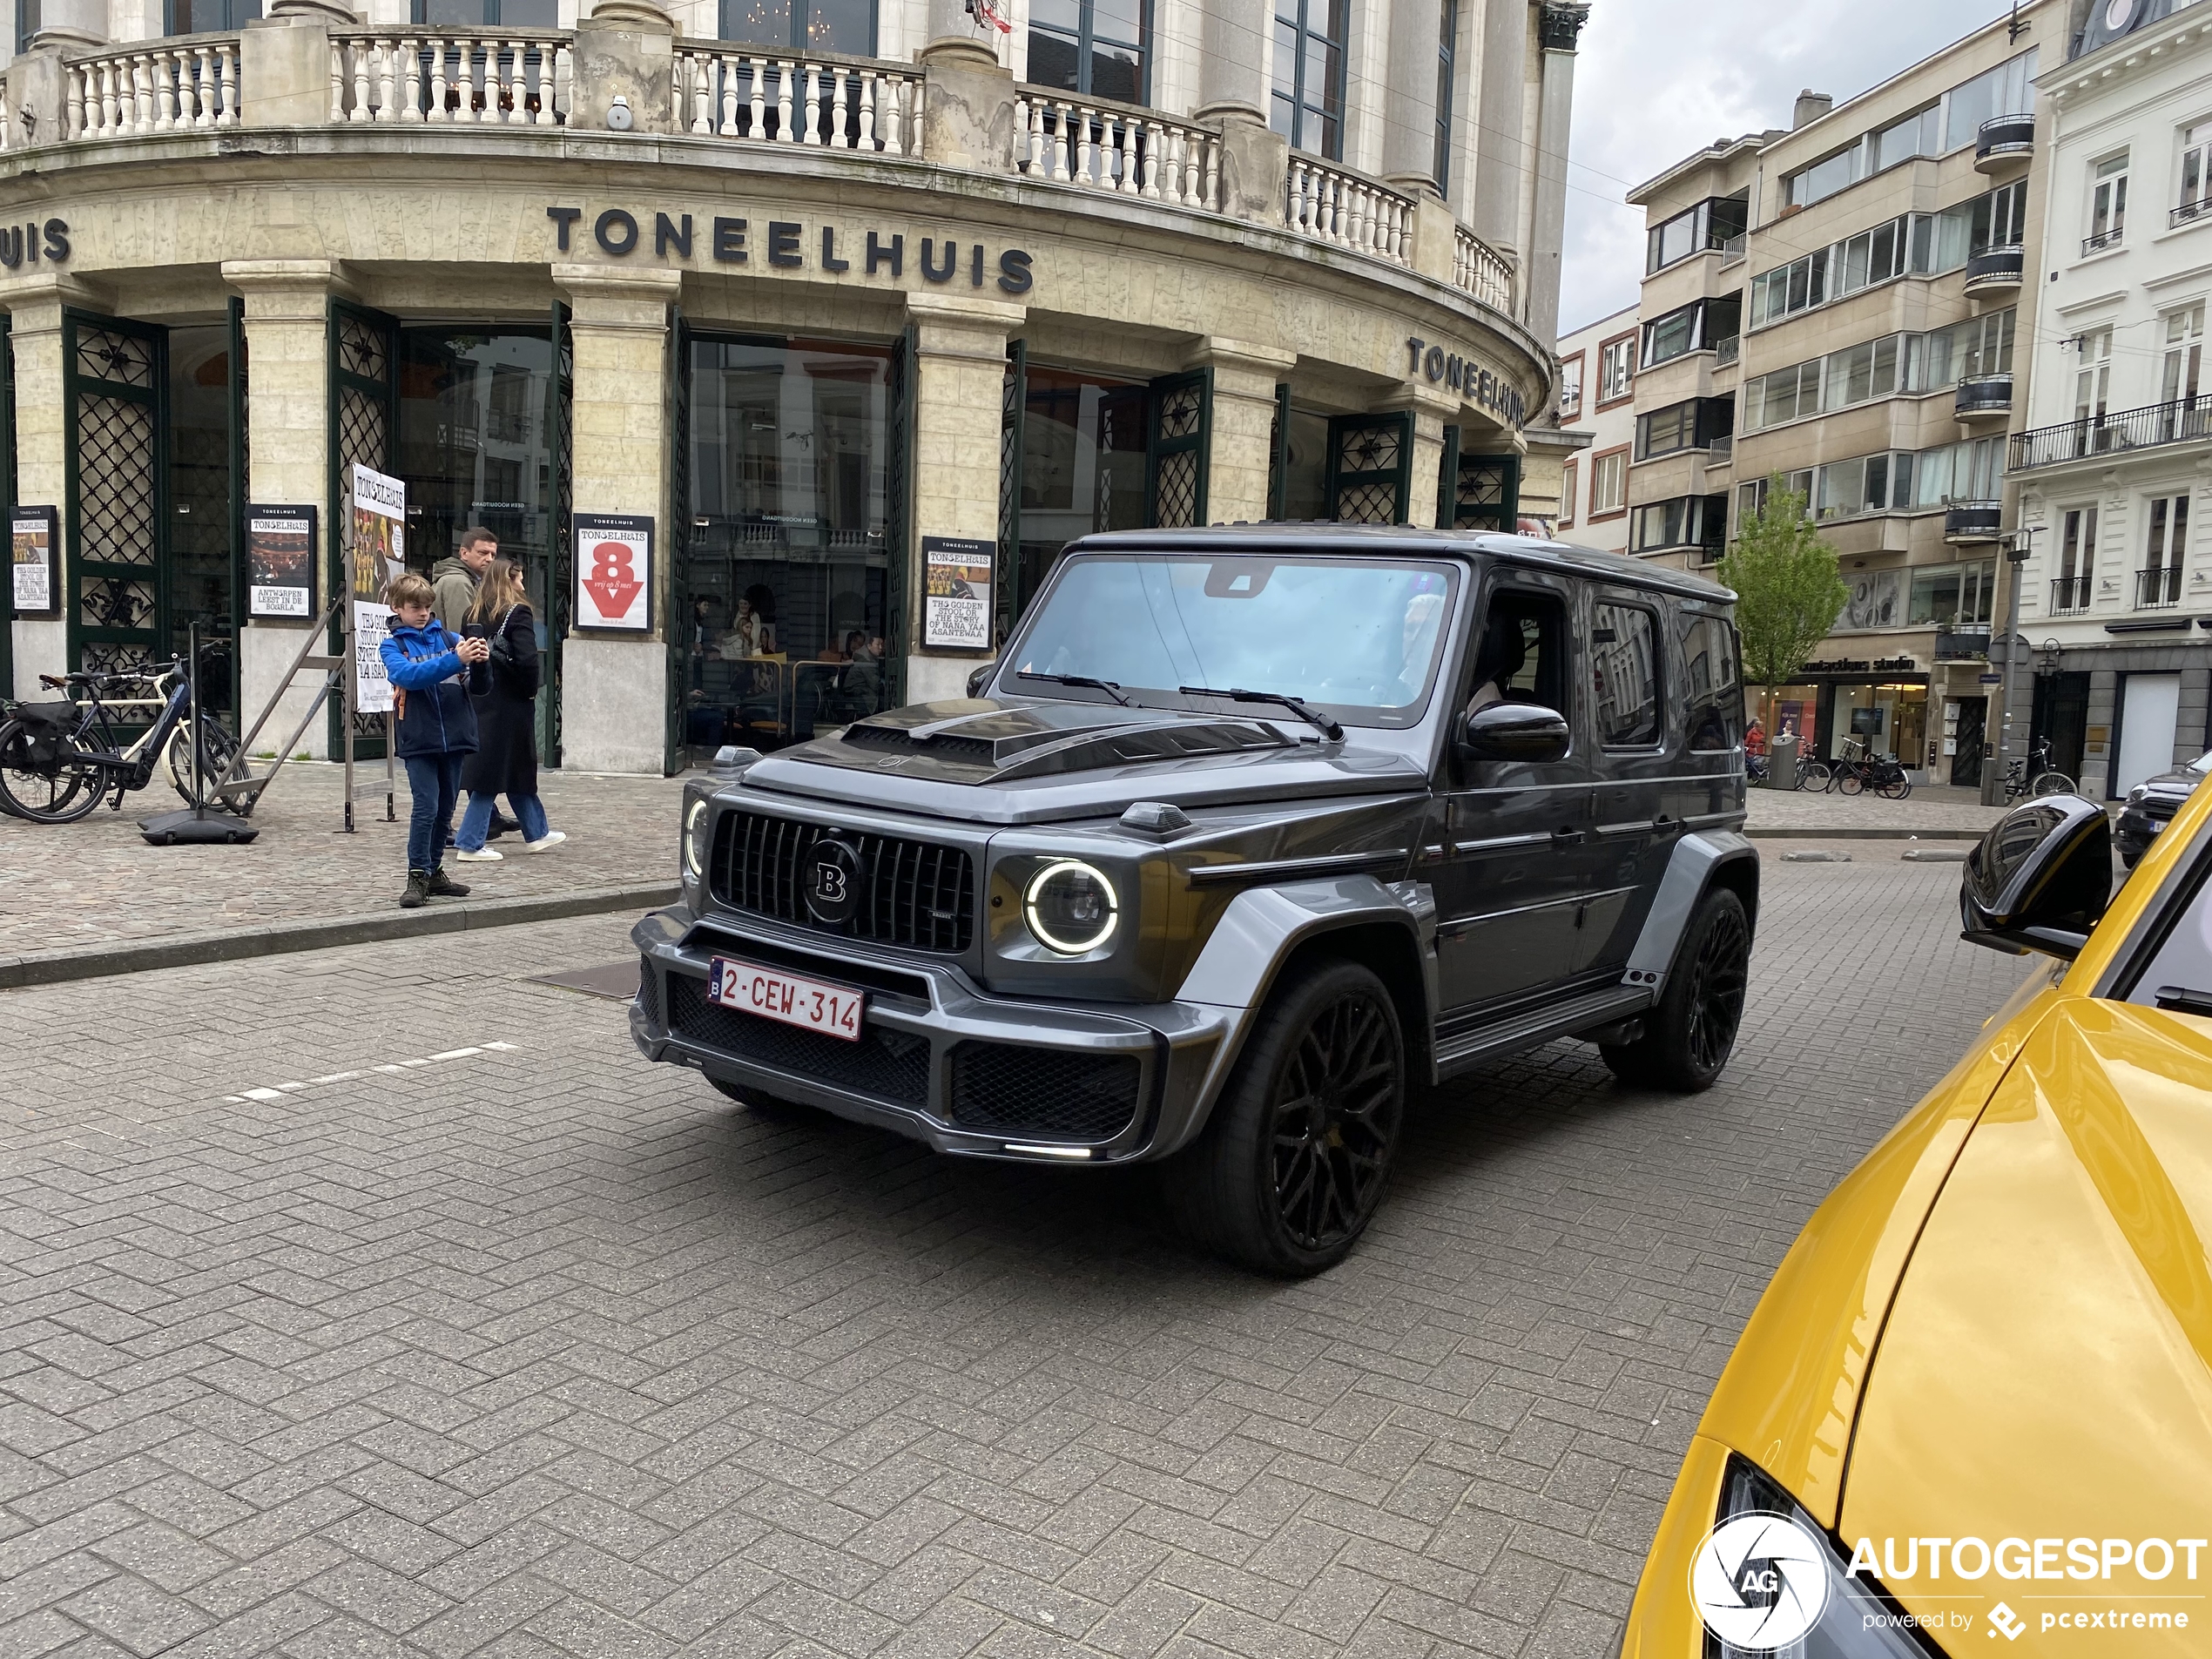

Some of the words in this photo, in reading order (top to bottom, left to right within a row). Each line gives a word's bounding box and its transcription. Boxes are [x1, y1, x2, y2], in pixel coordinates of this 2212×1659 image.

[547, 207, 1034, 293] TONEELHUIS
[1409, 336, 1525, 431] TONEELHUIS
[594, 581, 606, 590] vrij
[361, 630, 378, 646] STOOL
[932, 628, 982, 637] ASANTEWAA
[817, 862, 846, 902] B
[711, 981, 719, 995] B
[724, 968, 857, 1031] 2-CEW-314
